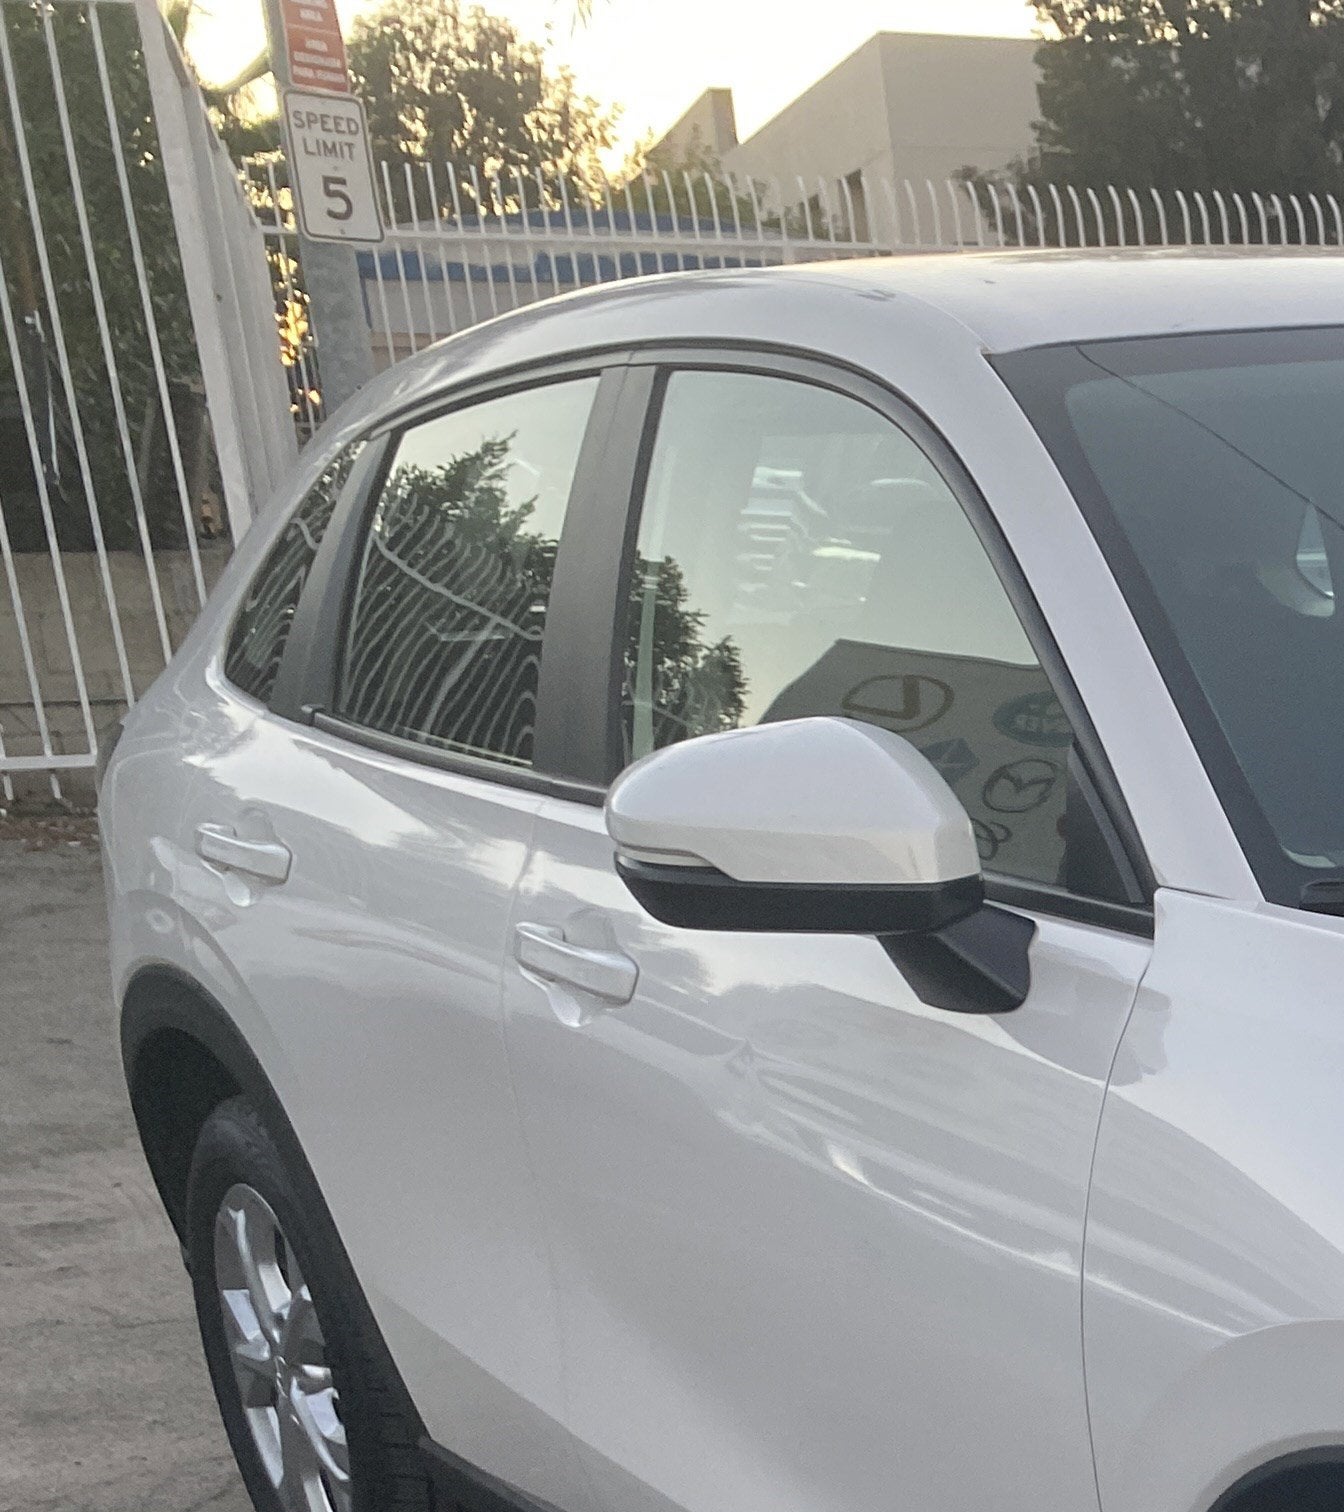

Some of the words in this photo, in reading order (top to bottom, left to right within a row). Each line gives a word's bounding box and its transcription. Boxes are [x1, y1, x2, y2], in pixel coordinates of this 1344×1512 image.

[293, 110, 359, 135] SPEED
[303, 137, 355, 160] LIMIT
[322, 176, 353, 221] 5
